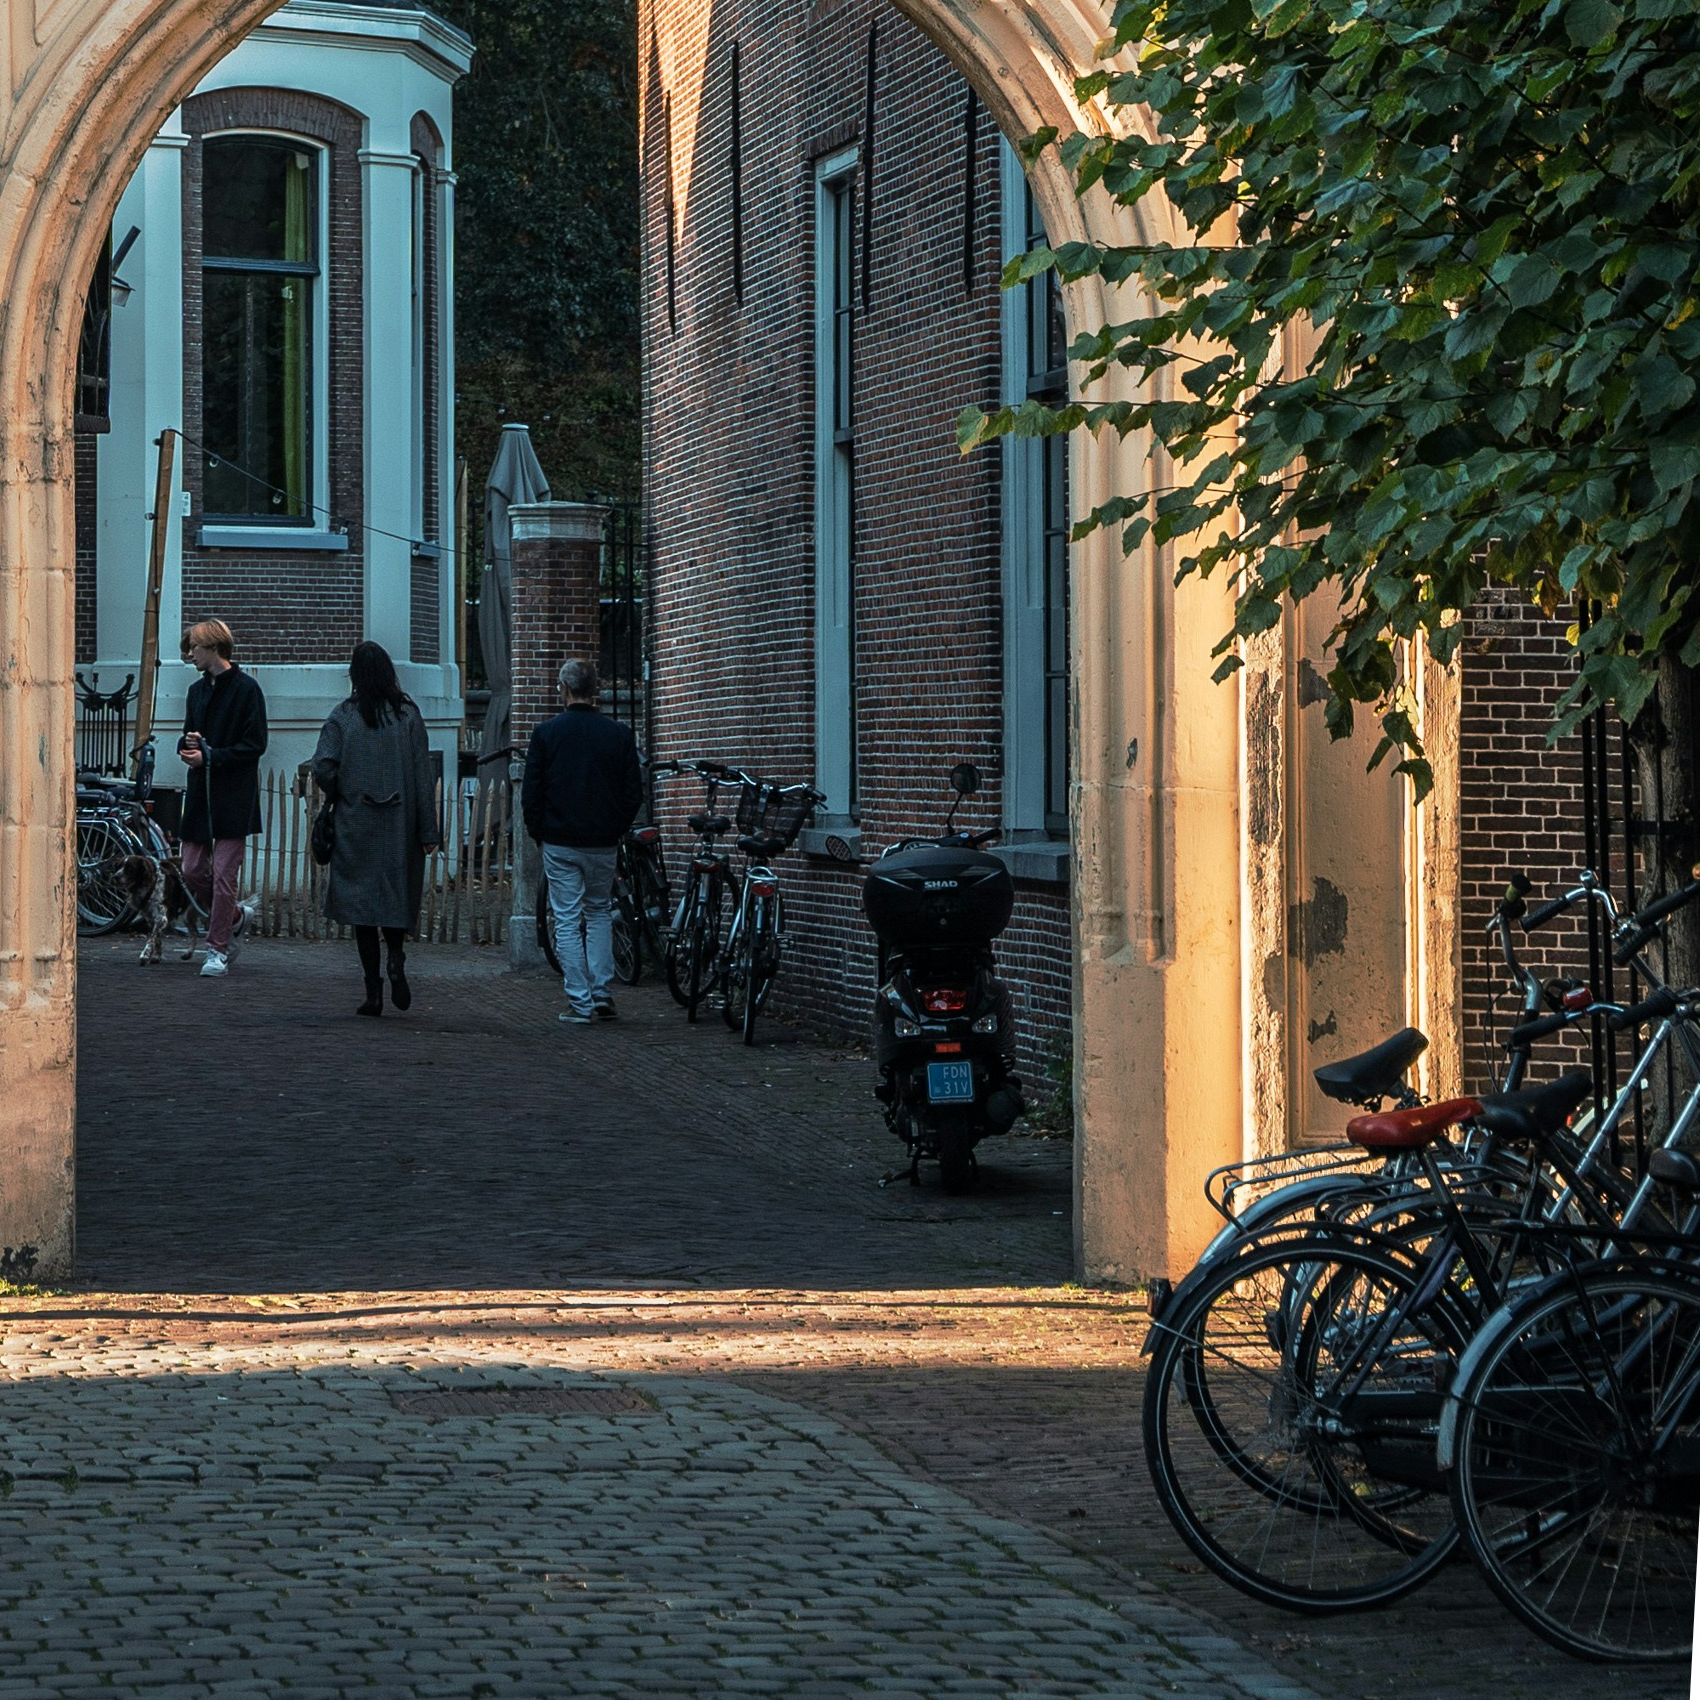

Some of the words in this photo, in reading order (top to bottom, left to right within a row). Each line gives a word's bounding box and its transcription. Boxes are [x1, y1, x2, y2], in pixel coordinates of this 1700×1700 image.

[924, 880, 958, 888] SHAD
[943, 1066, 968, 1079] FDN
[944, 1081, 968, 1094] 31V
